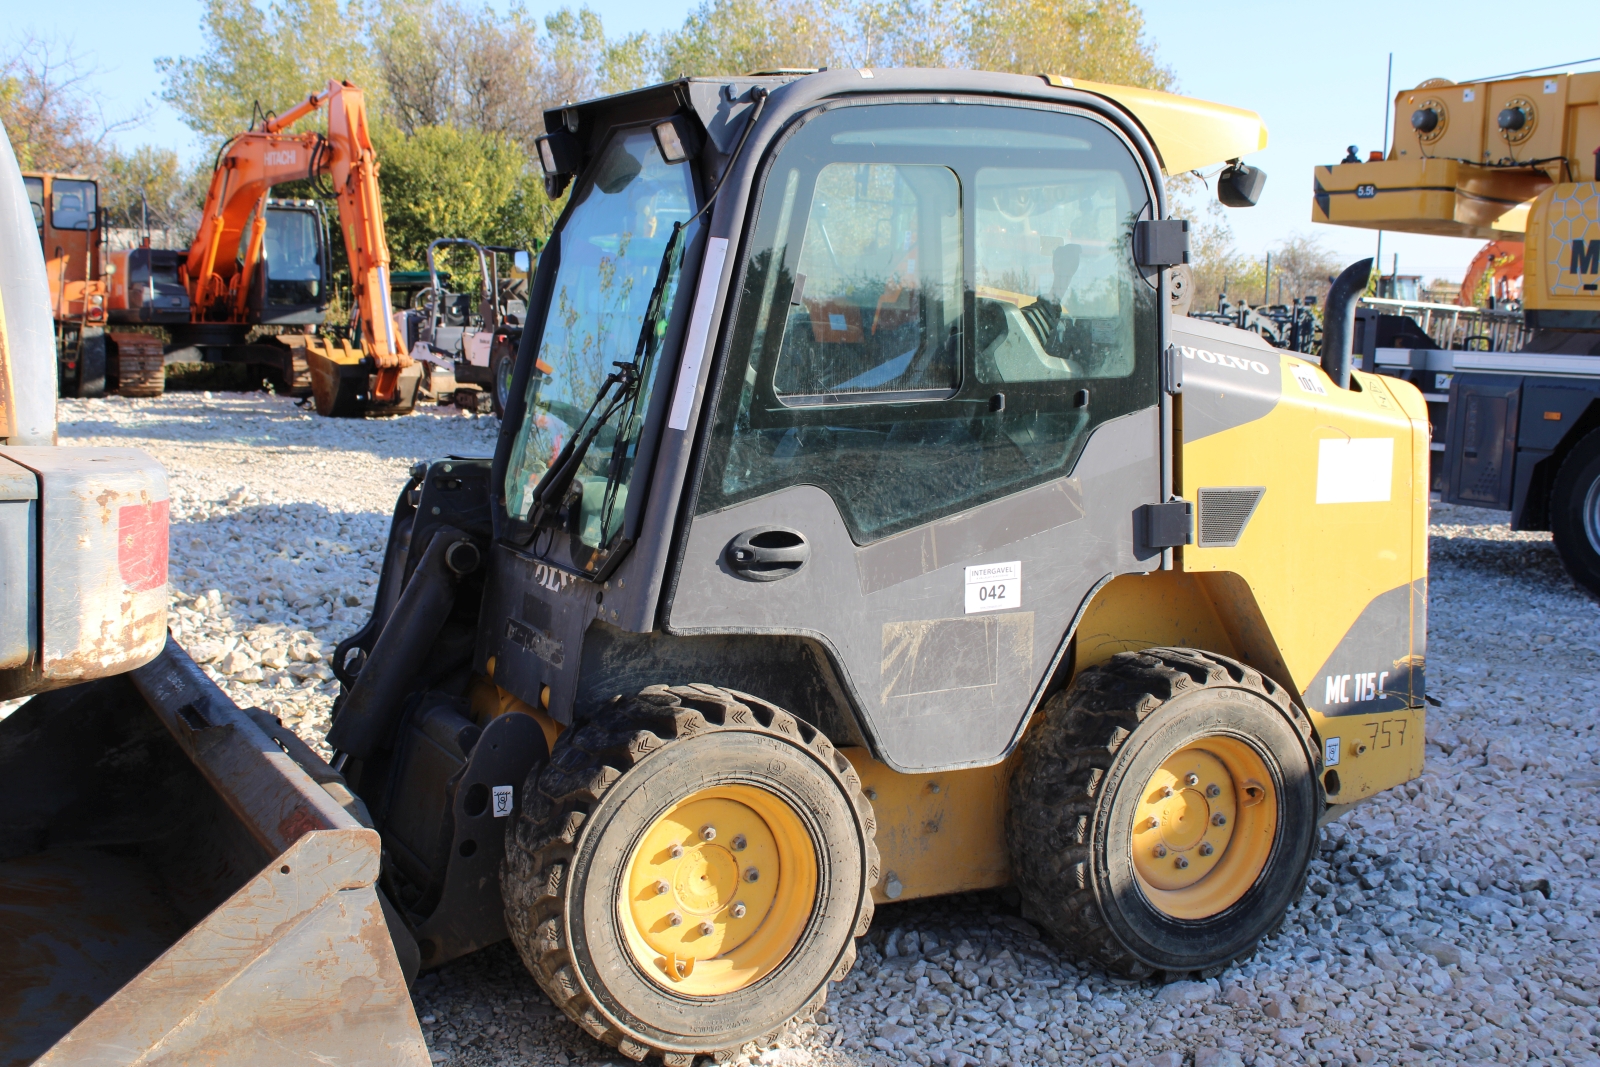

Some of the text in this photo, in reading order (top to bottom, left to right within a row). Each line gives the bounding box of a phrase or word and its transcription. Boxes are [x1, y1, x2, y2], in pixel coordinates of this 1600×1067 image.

[264, 150, 296, 166] HITACHI
[1358, 185, 1375, 197] 5.5t
[1181, 345, 1270, 375] VOLVO
[971, 566, 1013, 577] INTERGAVEL
[979, 584, 1006, 602] 042
[1325, 674, 1351, 705] MC
[1362, 718, 1407, 750] 757
